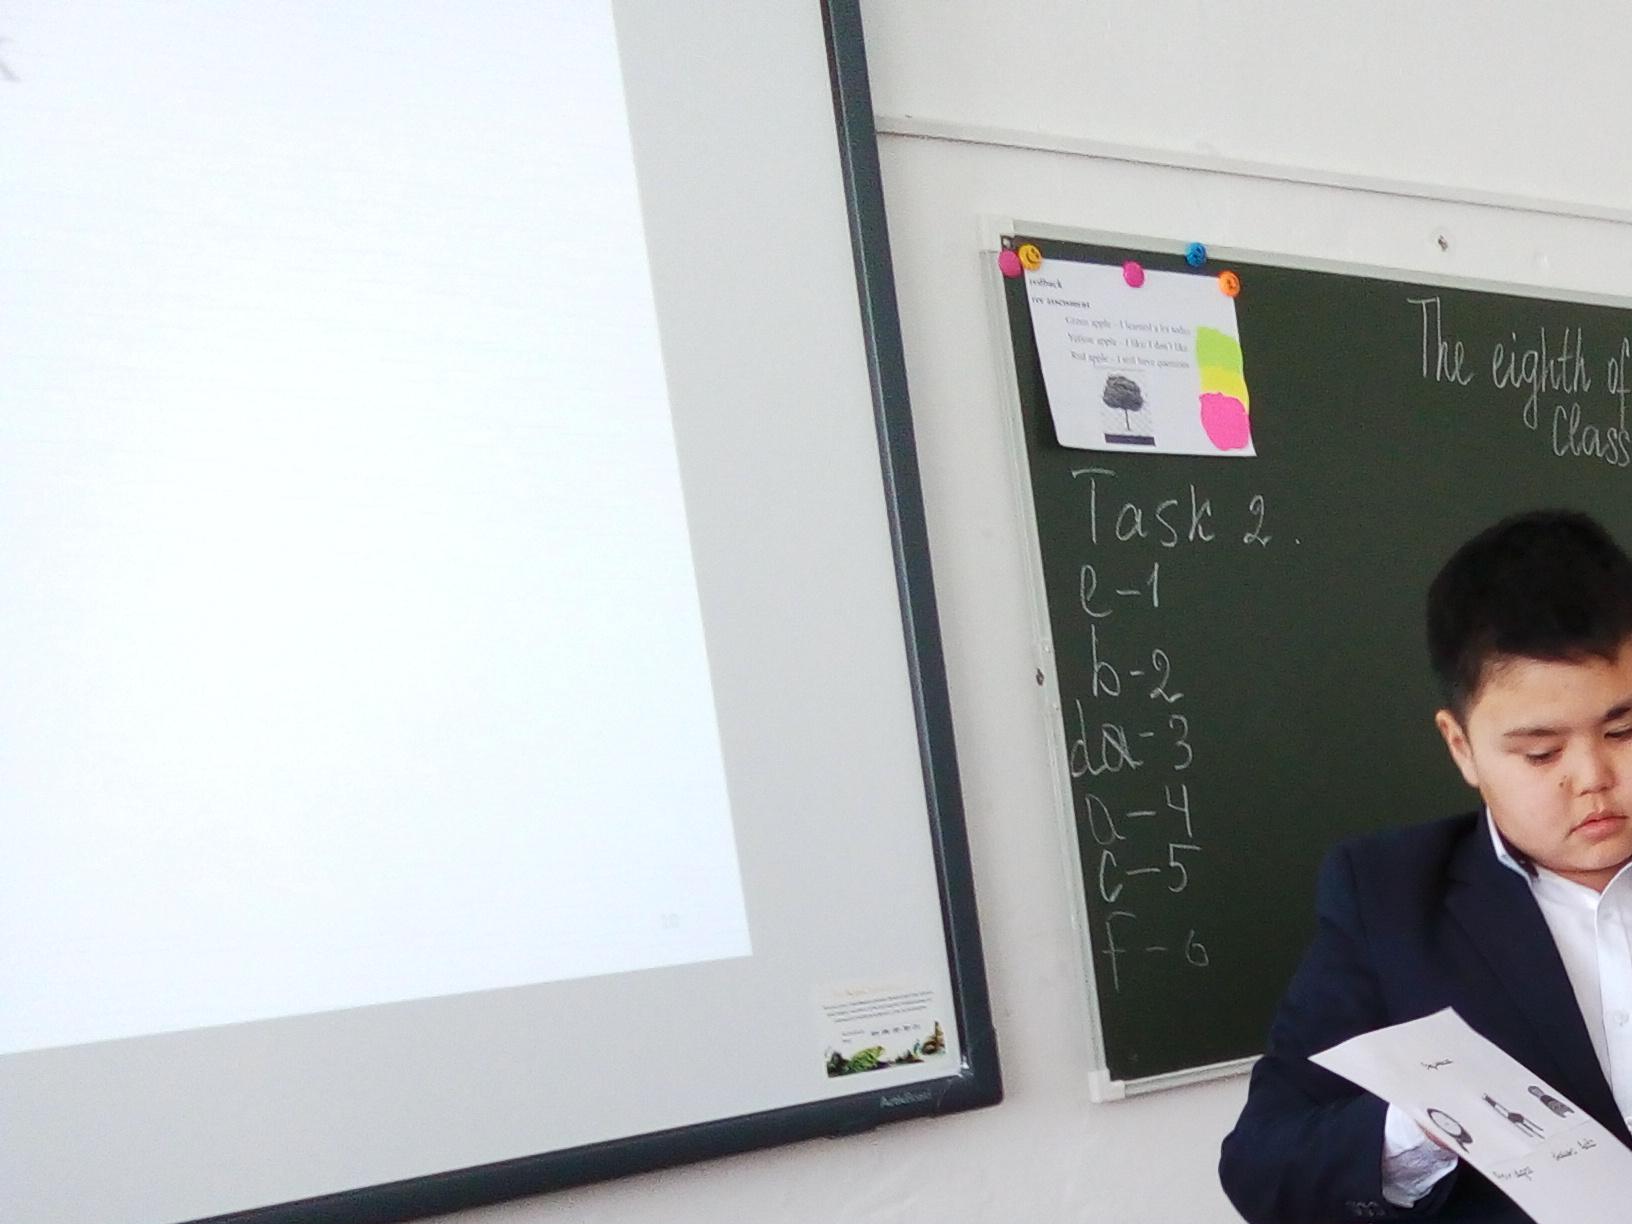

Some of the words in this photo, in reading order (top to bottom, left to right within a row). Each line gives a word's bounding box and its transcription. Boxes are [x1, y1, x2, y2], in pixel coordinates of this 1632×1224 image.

[1407, 296, 1474, 386] The
[1492, 326, 1592, 430] eighth
[1607, 337, 1631, 430] of
[1551, 402, 1631, 468] Class
[1071, 467, 1215, 548] Task
